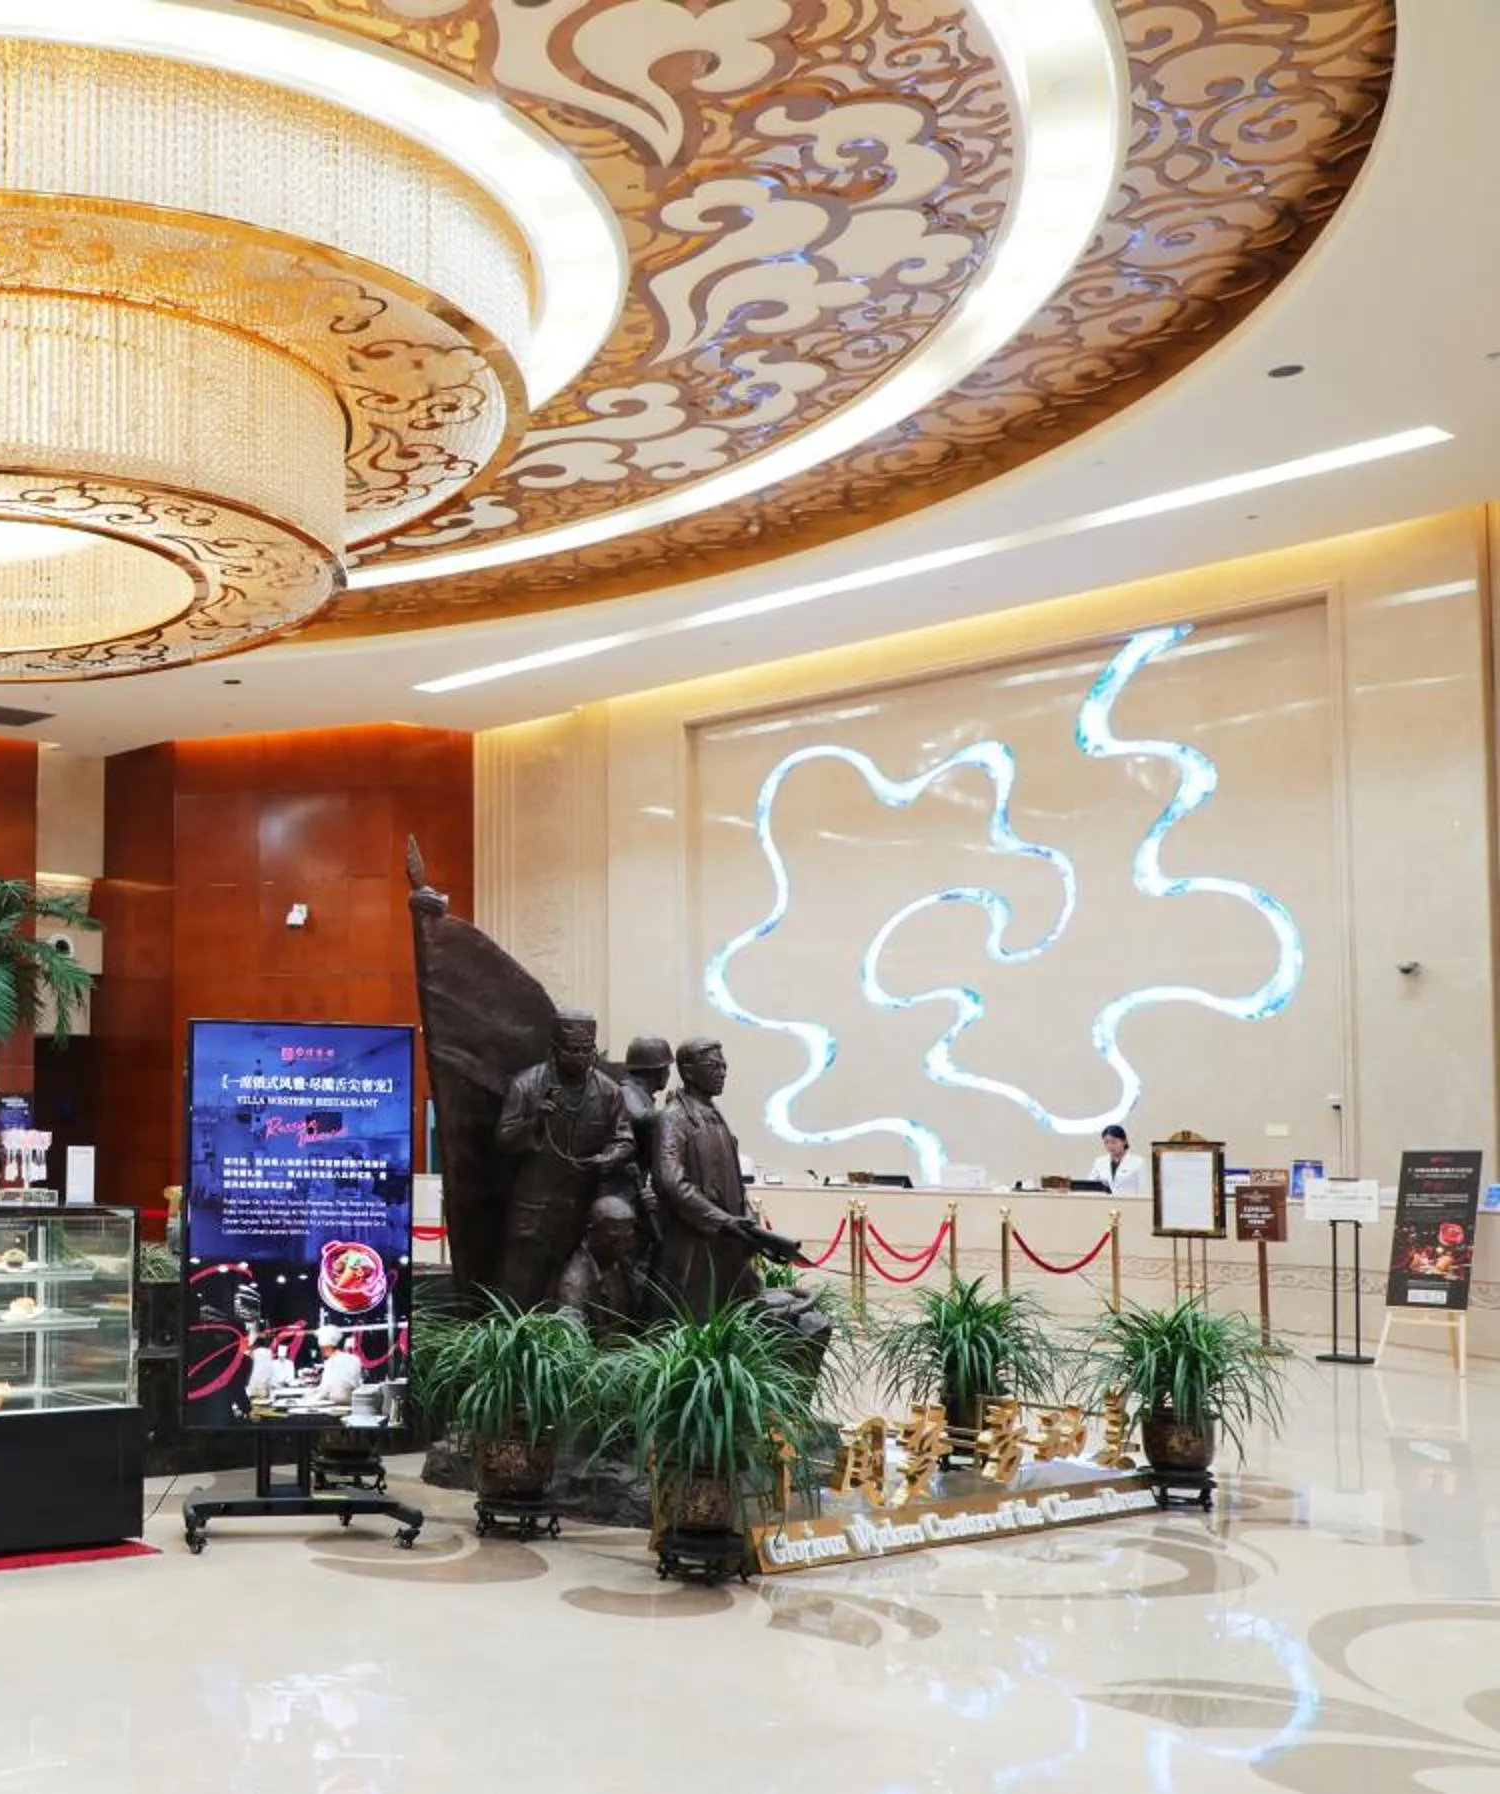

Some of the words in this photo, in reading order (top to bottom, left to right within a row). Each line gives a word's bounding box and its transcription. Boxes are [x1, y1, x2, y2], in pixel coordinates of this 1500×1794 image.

[315, 1098, 379, 1108] RESTAURANT
[765, 1522, 849, 1565] Glorious
[996, 1501, 1017, 1529] of
[1015, 1500, 1045, 1527] the
